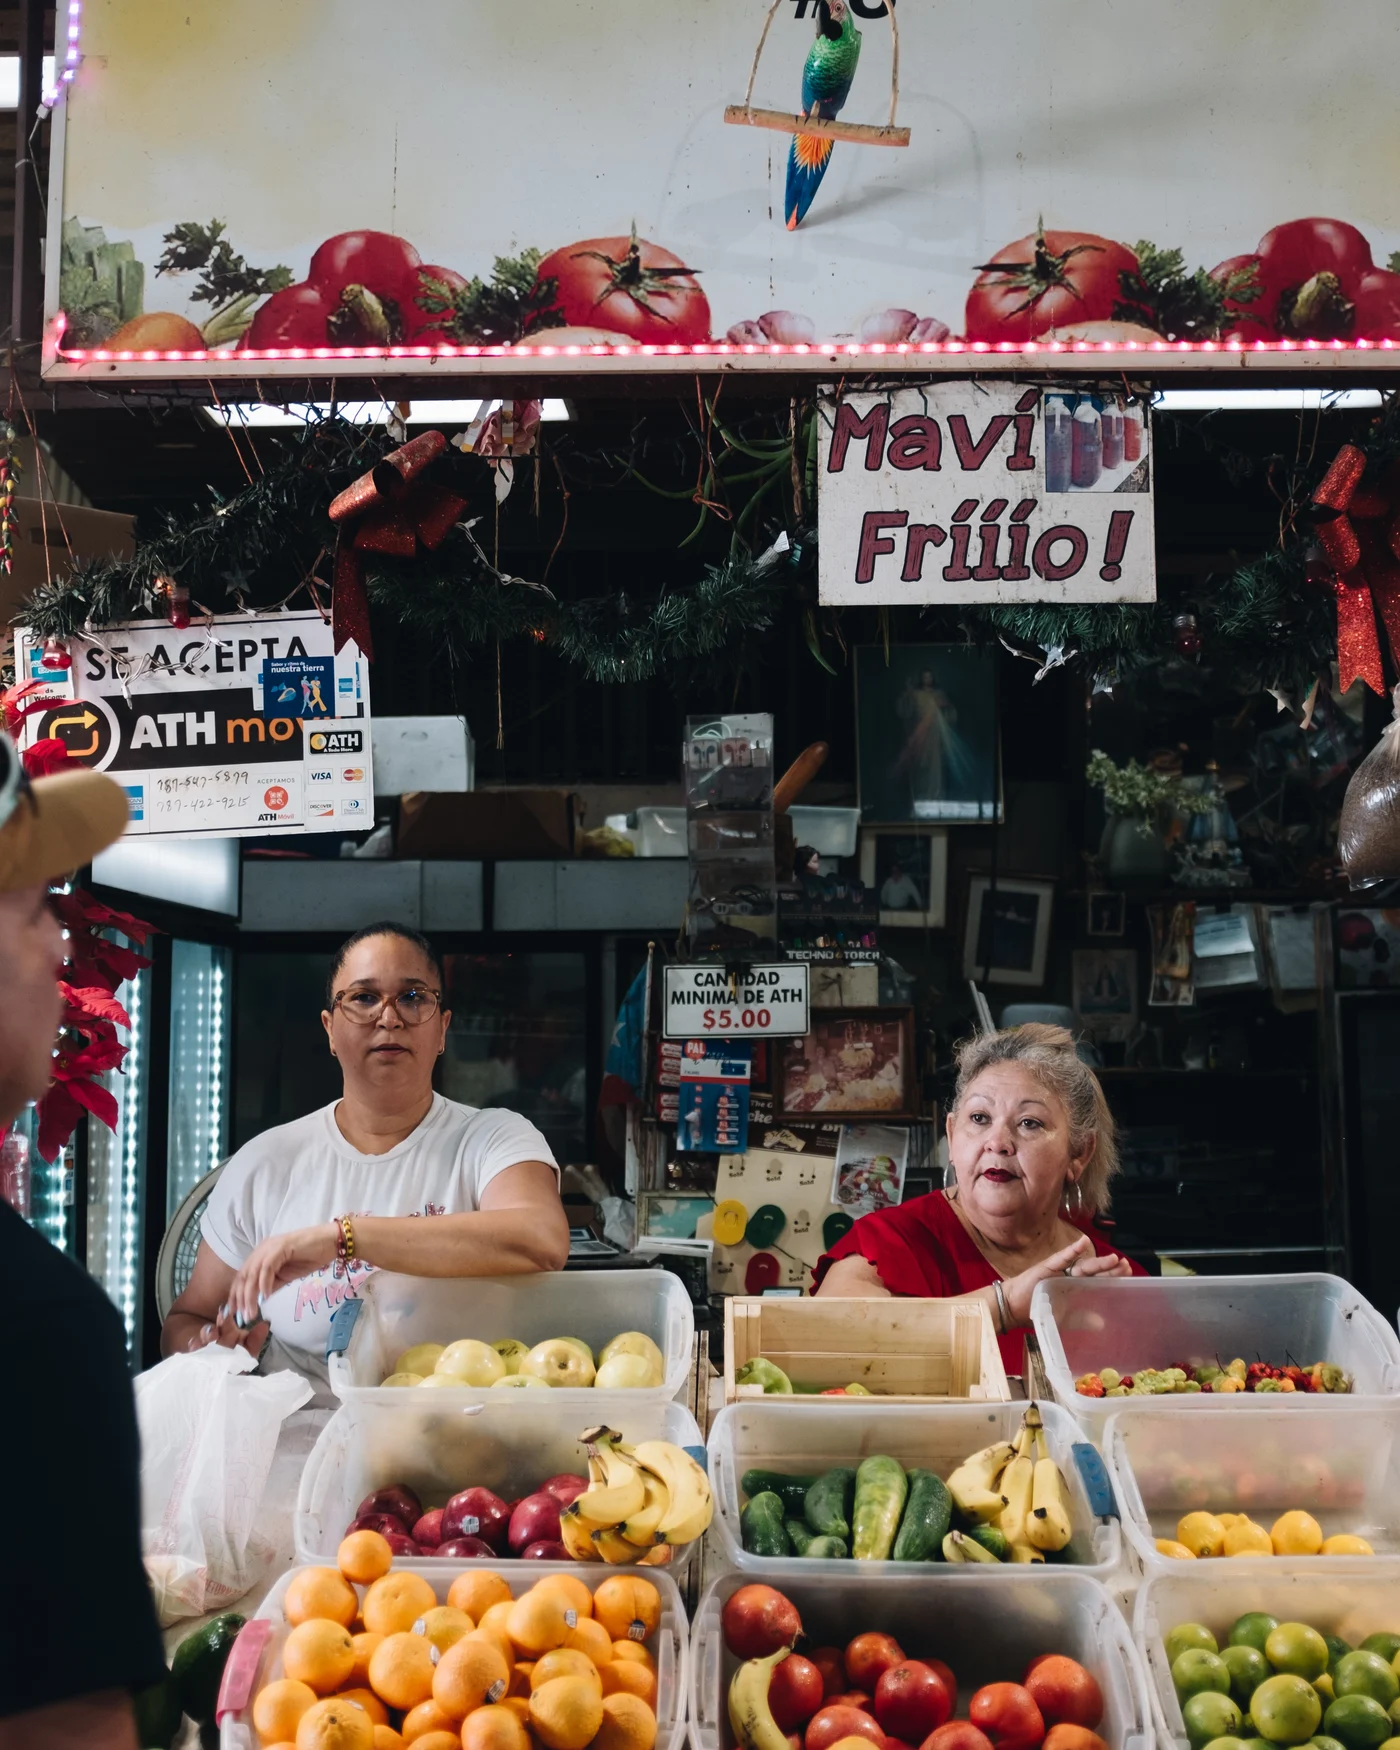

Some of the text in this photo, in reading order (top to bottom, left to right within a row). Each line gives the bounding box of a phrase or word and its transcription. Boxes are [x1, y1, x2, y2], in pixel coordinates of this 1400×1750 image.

[827, 388, 1036, 473] Maví
[86, 636, 309, 681] SE ACEPTA
[271, 664, 325, 673] nuestra tierra
[130, 711, 216, 749] ATH
[328, 733, 359, 747] ATH
[311, 772, 332, 780] VISA
[257, 813, 277, 821] ATH
[843, 951, 881, 960] TORCH
[694, 971, 780, 987] CANIDAD
[671, 988, 802, 1005] MINIMA DE ATH
[703, 1008, 771, 1031] $5.00
[687, 1041, 705, 1054] PAL
[747, 1110, 773, 1124] cke
